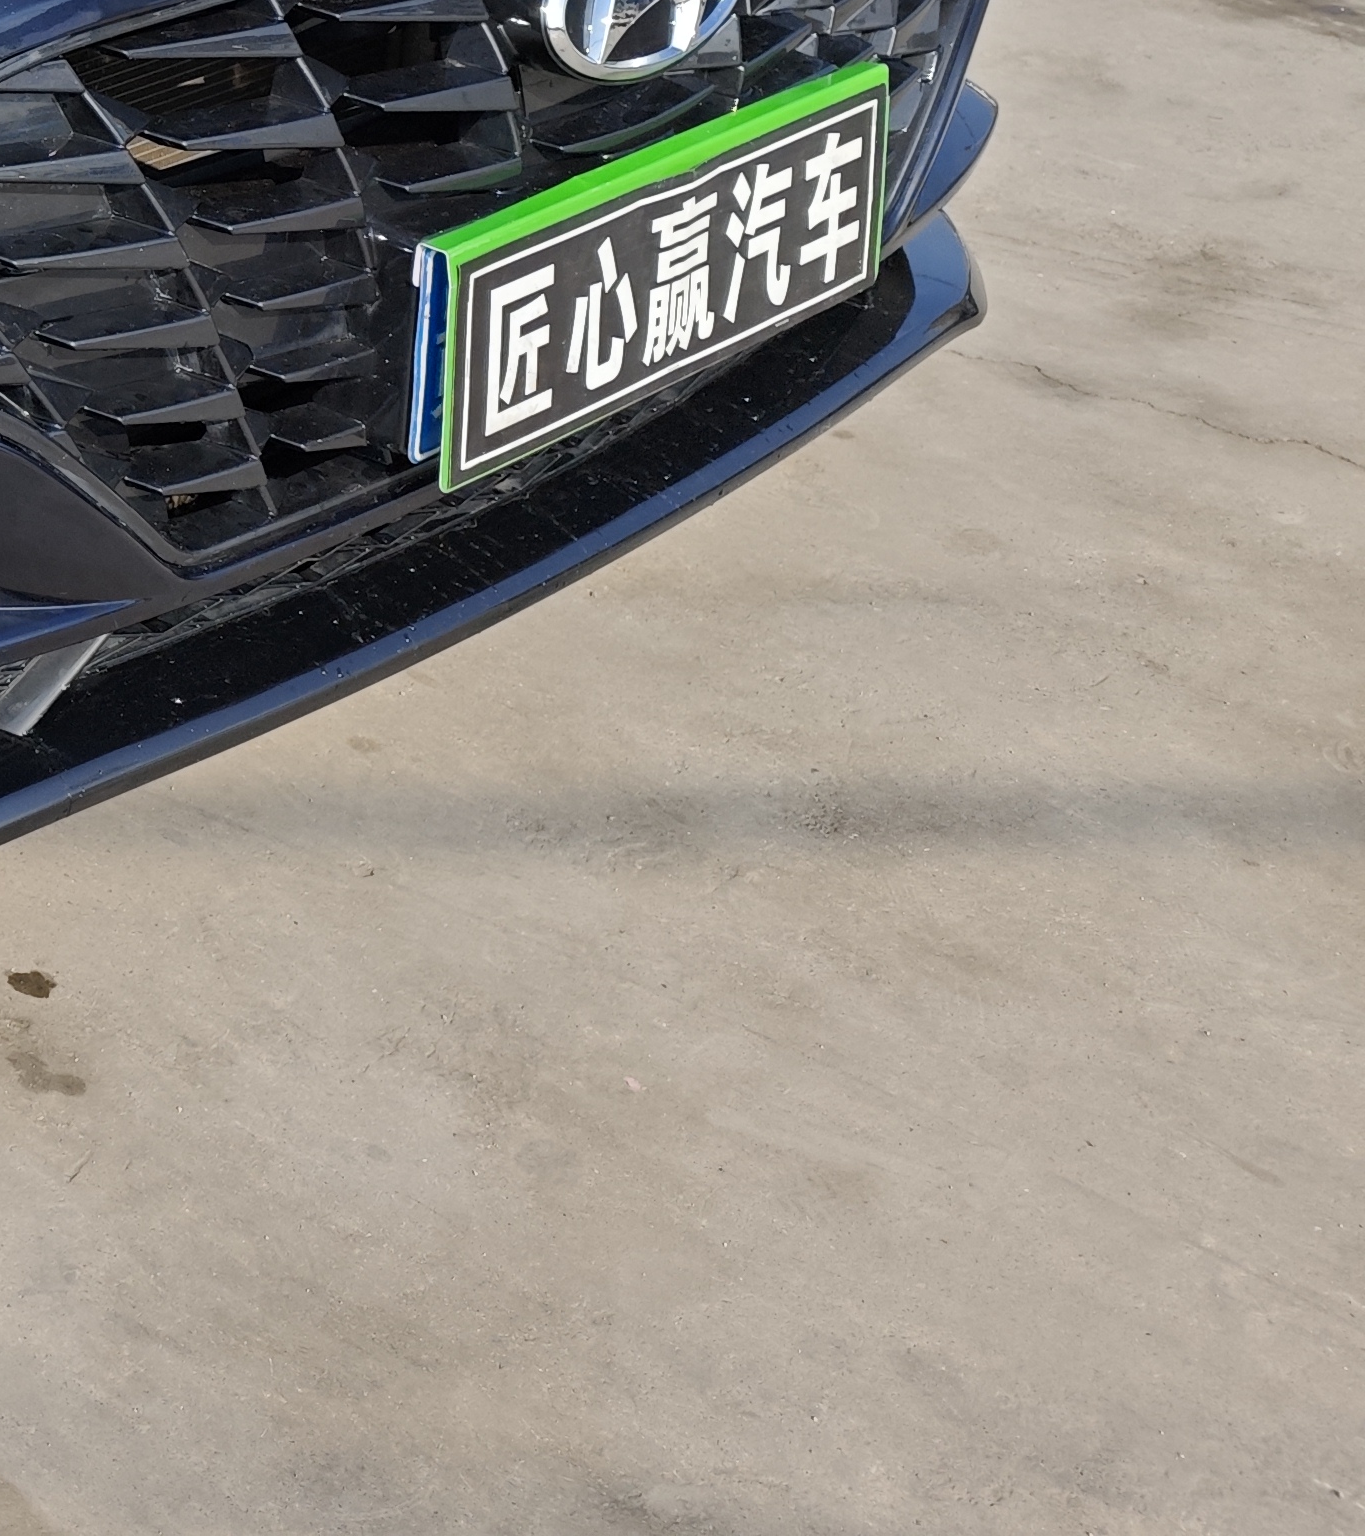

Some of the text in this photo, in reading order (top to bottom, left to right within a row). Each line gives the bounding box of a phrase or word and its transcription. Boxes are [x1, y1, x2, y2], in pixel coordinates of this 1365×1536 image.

[484, 131, 863, 437] 匠心赢汽车
